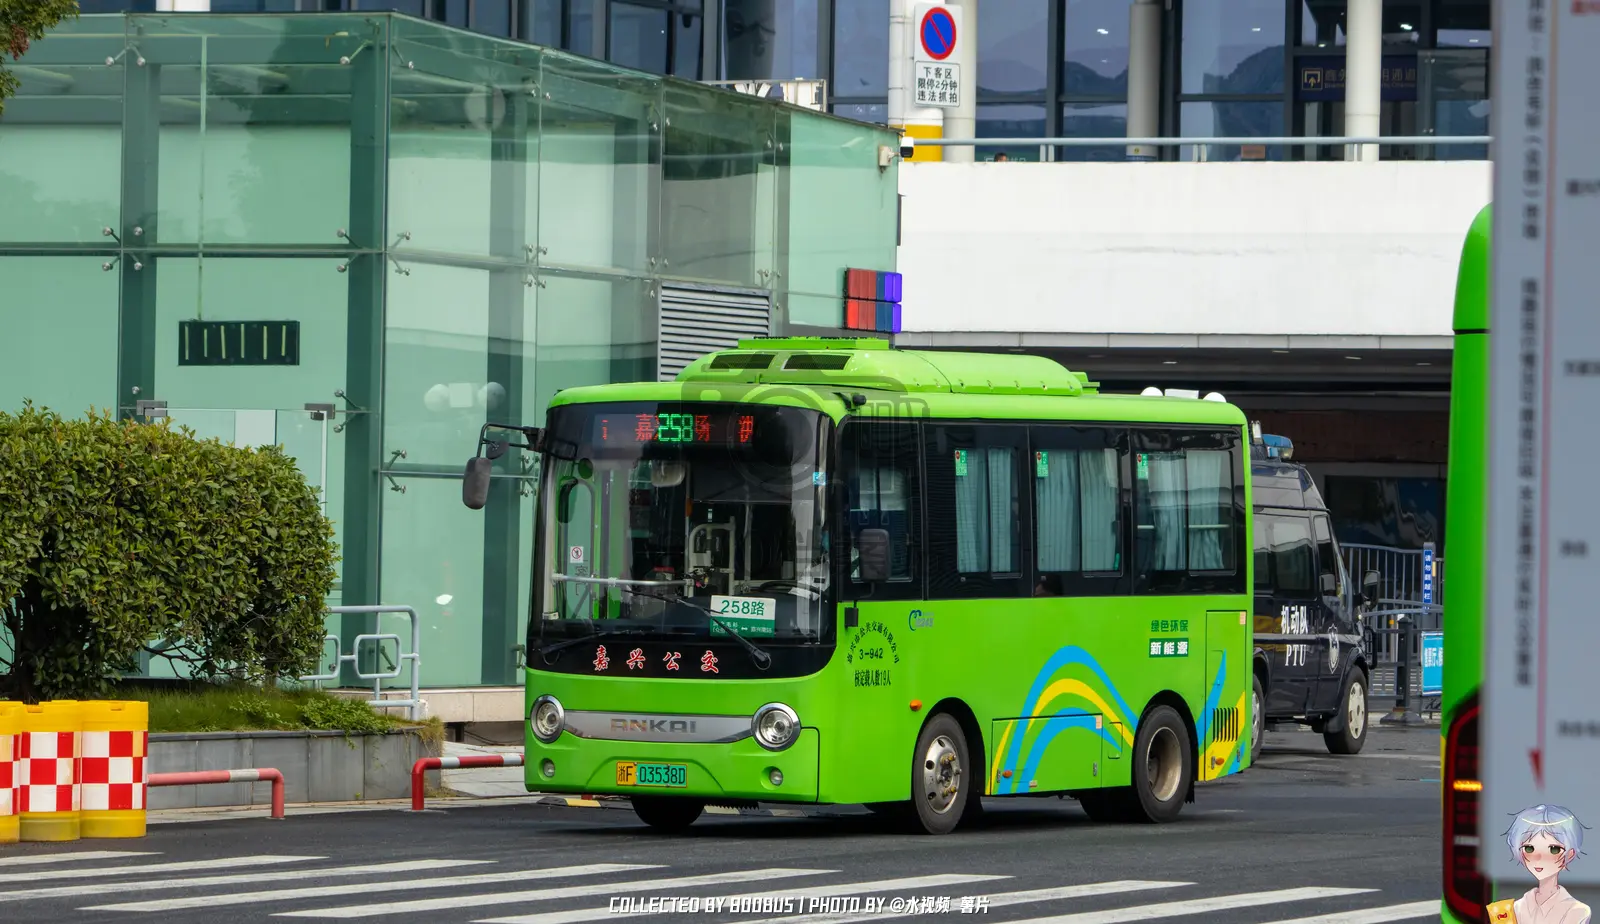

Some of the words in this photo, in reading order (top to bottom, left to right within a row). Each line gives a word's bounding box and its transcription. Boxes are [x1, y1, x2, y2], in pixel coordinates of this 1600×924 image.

[923, 66, 952, 79] 下客区
[918, 78, 958, 91] 限停2分钟
[918, 90, 958, 103] 违法抓拍
[658, 413, 694, 442] 258
[721, 599, 765, 616] 258路
[1151, 619, 1188, 632] 绿色环保
[1281, 605, 1308, 635] 机动队
[859, 647, 884, 660] 3-942
[1150, 641, 1188, 655] 新能源
[1285, 644, 1307, 667] PTU
[593, 645, 719, 673] 嘉兴公交
[854, 669, 892, 687] 核定载人数19人
[610, 718, 697, 733] ANKAI
